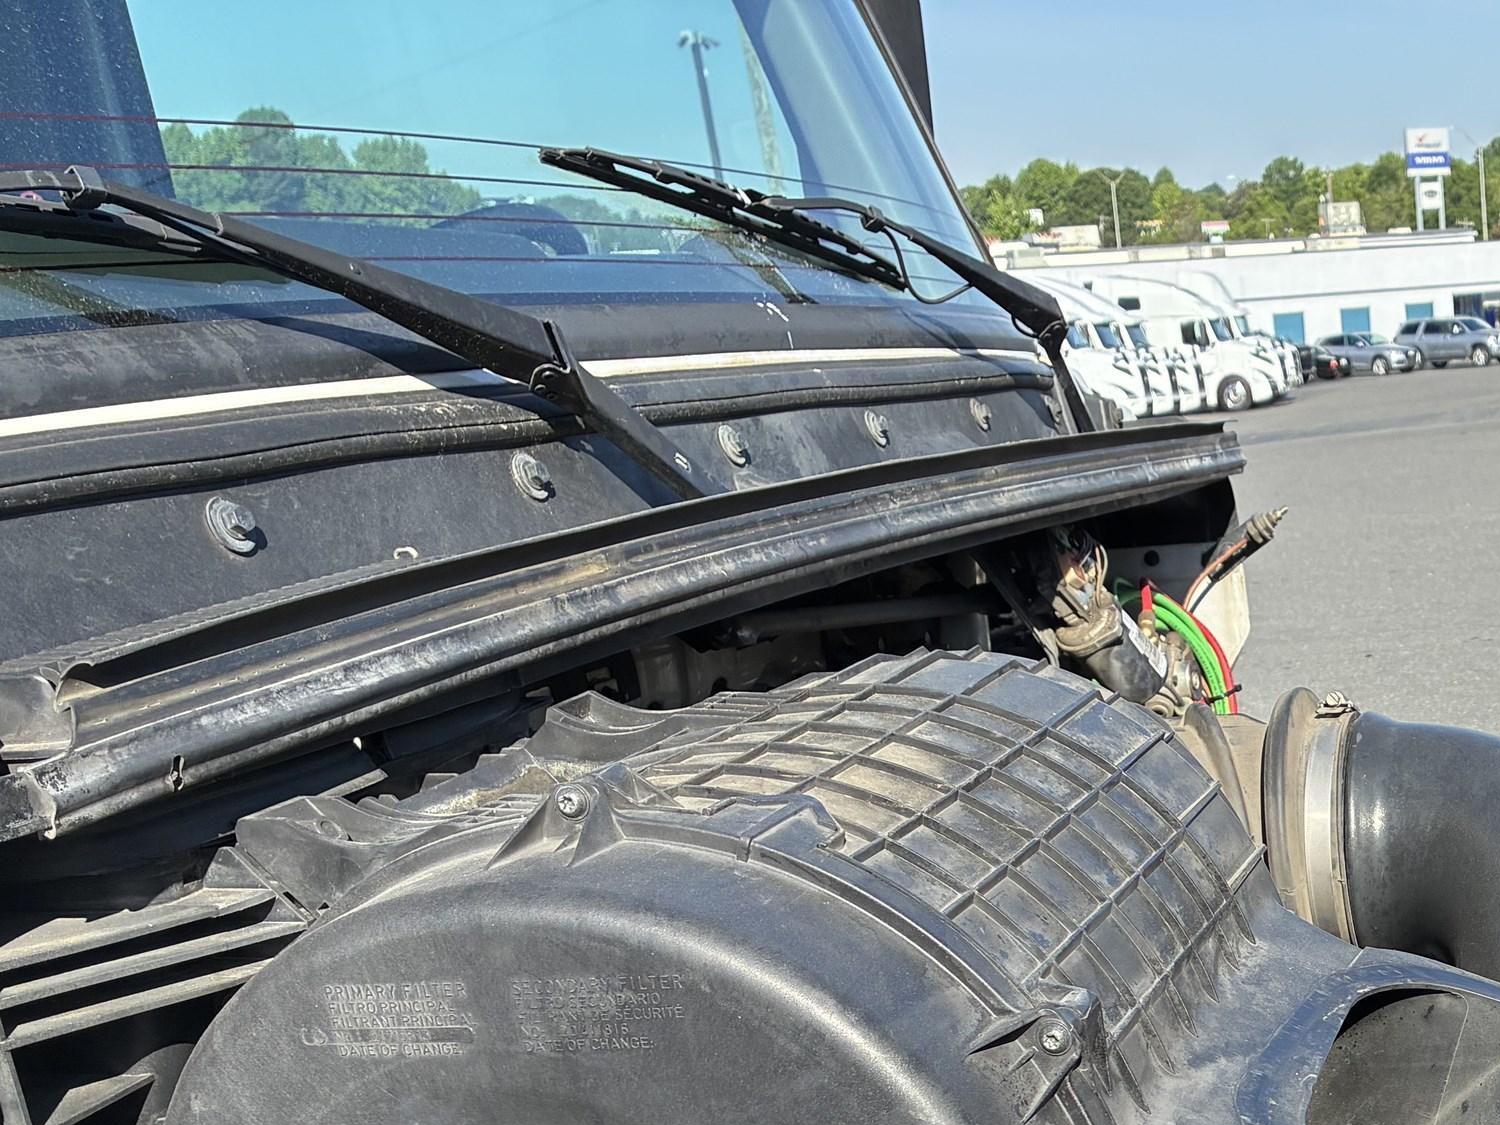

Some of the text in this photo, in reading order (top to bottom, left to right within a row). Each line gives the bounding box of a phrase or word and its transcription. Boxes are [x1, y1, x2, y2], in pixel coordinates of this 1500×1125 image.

[324, 981, 467, 1000] PRIMARY FILTER
[512, 975, 684, 995] SECONDARY FILTER
[328, 1000, 456, 1015] FILTRO PRINCIPAL
[568, 992, 661, 1008] SECUNDARIO
[331, 1013, 477, 1028] FILTRANT PRINCIPAL
[339, 1044, 377, 1057] DATE
[381, 1044, 399, 1056] OF
[523, 1039, 564, 1051] DATE
[568, 1038, 586, 1050] OF
